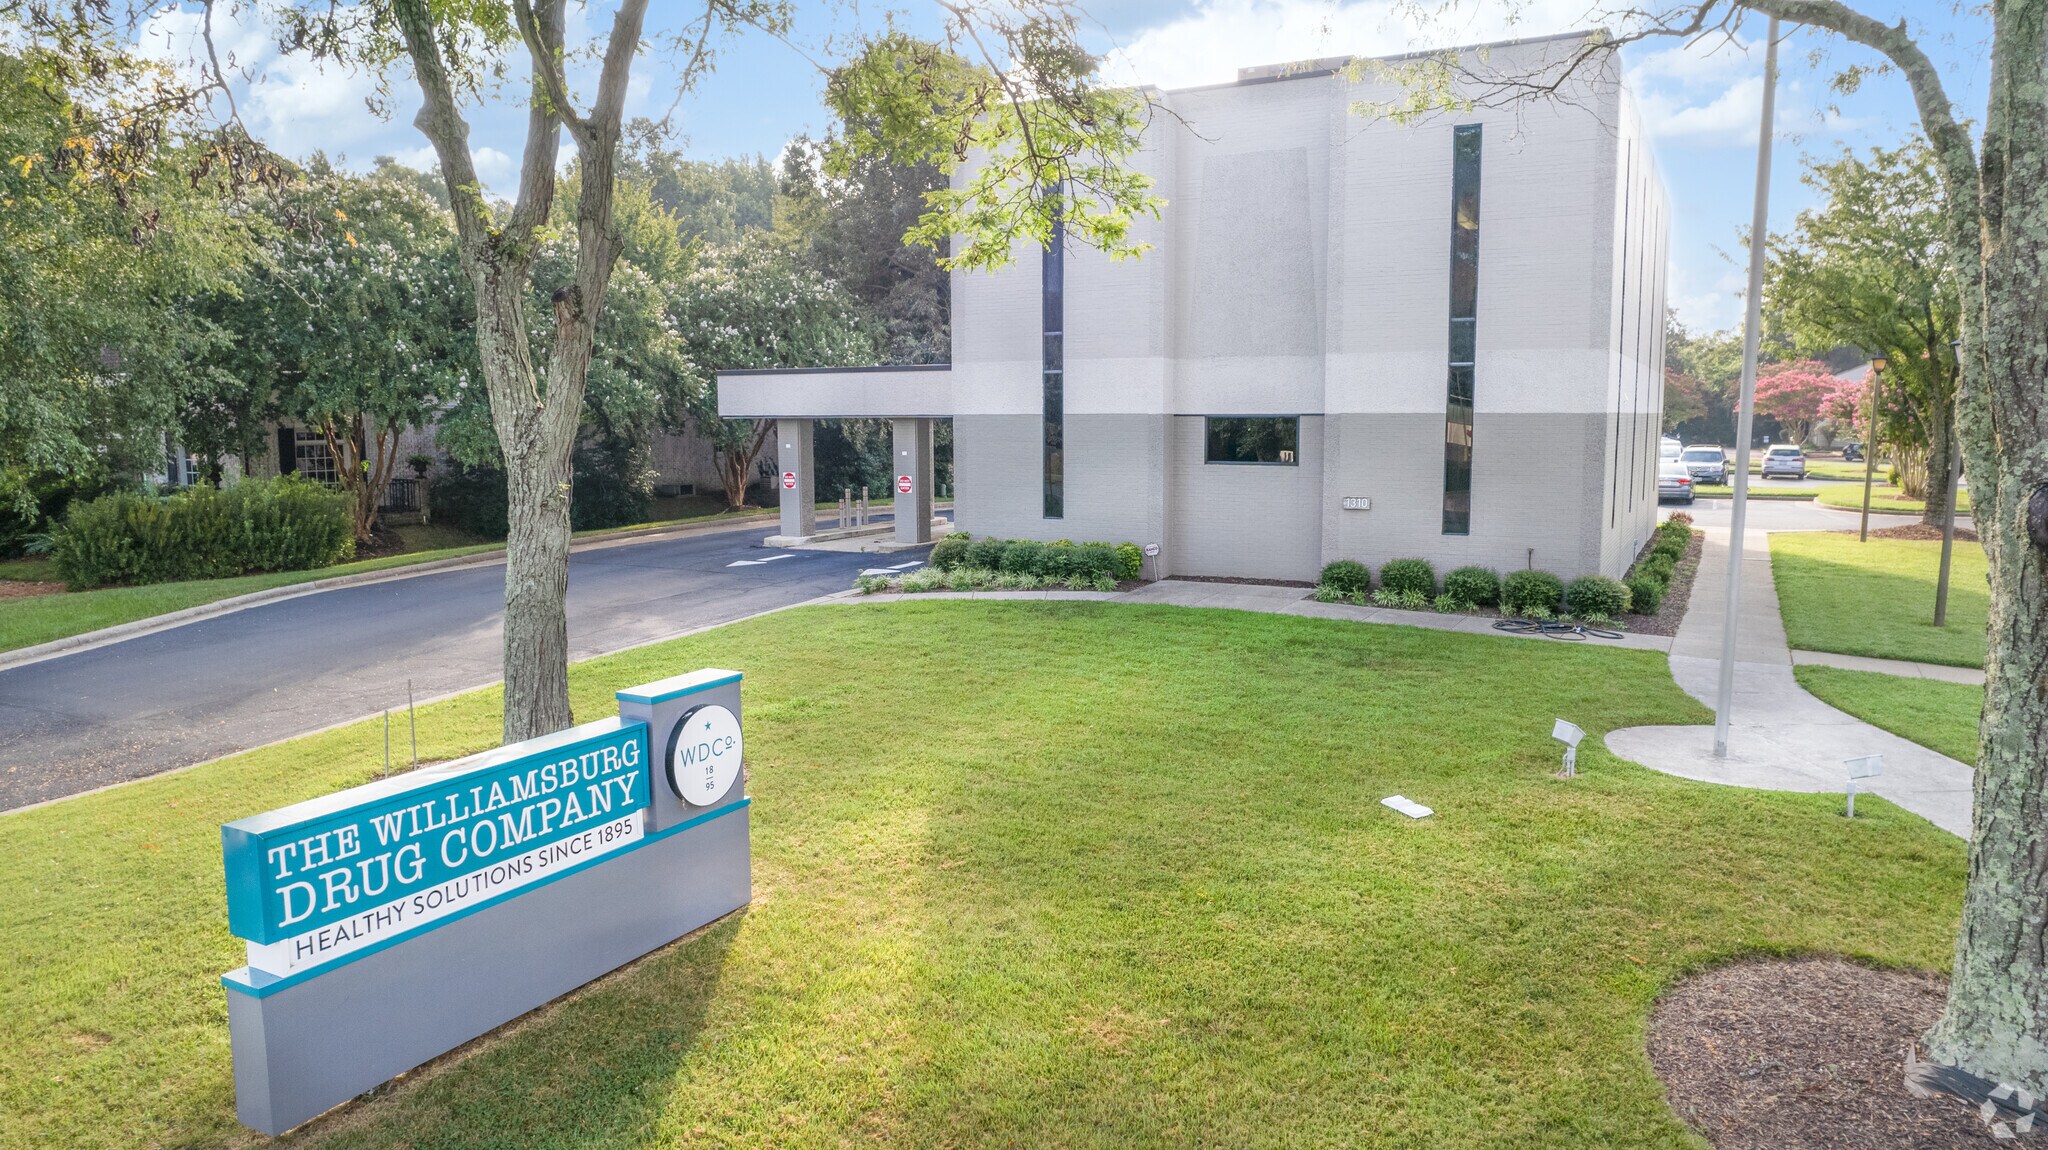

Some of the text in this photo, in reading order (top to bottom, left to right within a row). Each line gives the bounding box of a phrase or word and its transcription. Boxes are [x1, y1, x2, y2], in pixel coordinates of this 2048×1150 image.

[1346, 498, 1368, 508] 1310
[705, 765, 714, 775] 18
[705, 781, 715, 791] 95
[267, 738, 641, 880] THE WILLIAMSBURG
[275, 770, 640, 928] DRUG COMPANY
[296, 818, 633, 960] HEALTHY SOLUTIONS SINCE 1895
